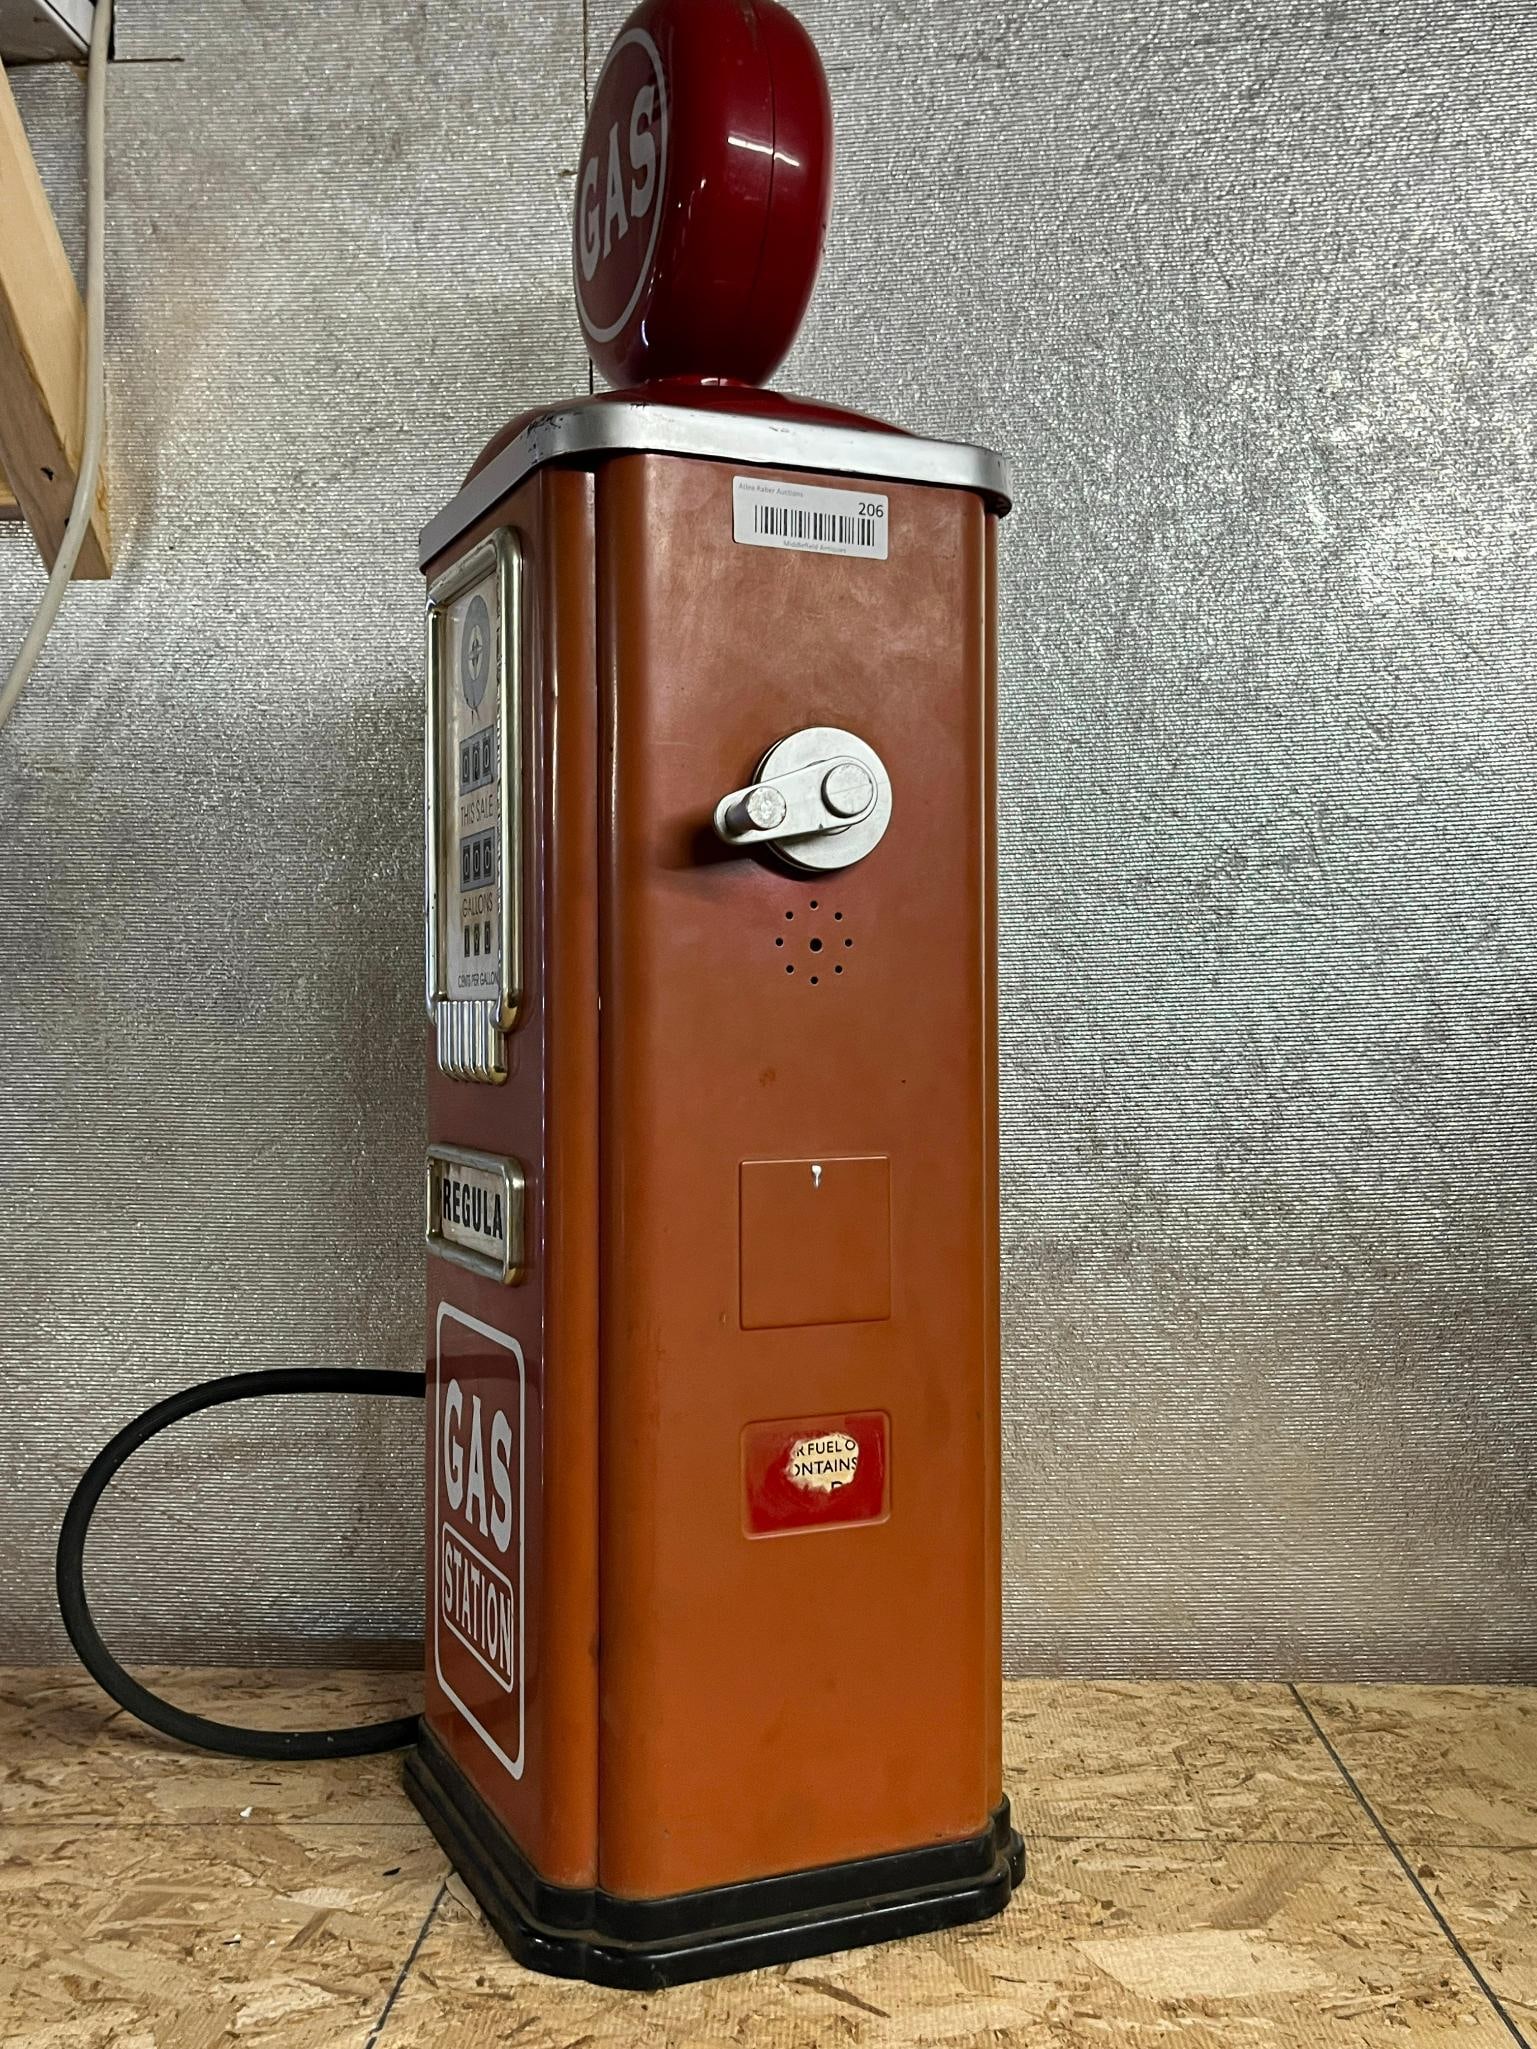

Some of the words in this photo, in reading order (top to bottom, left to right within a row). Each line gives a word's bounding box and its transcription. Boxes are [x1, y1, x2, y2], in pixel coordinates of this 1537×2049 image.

[579, 84, 656, 282] GAS
[858, 502, 884, 518] 206
[460, 802, 475, 827] THIS
[476, 794, 494, 822] SALE
[463, 892, 493, 917] GALLONS
[444, 1379, 512, 1553] GAS
[445, 1541, 511, 1677] STATION
